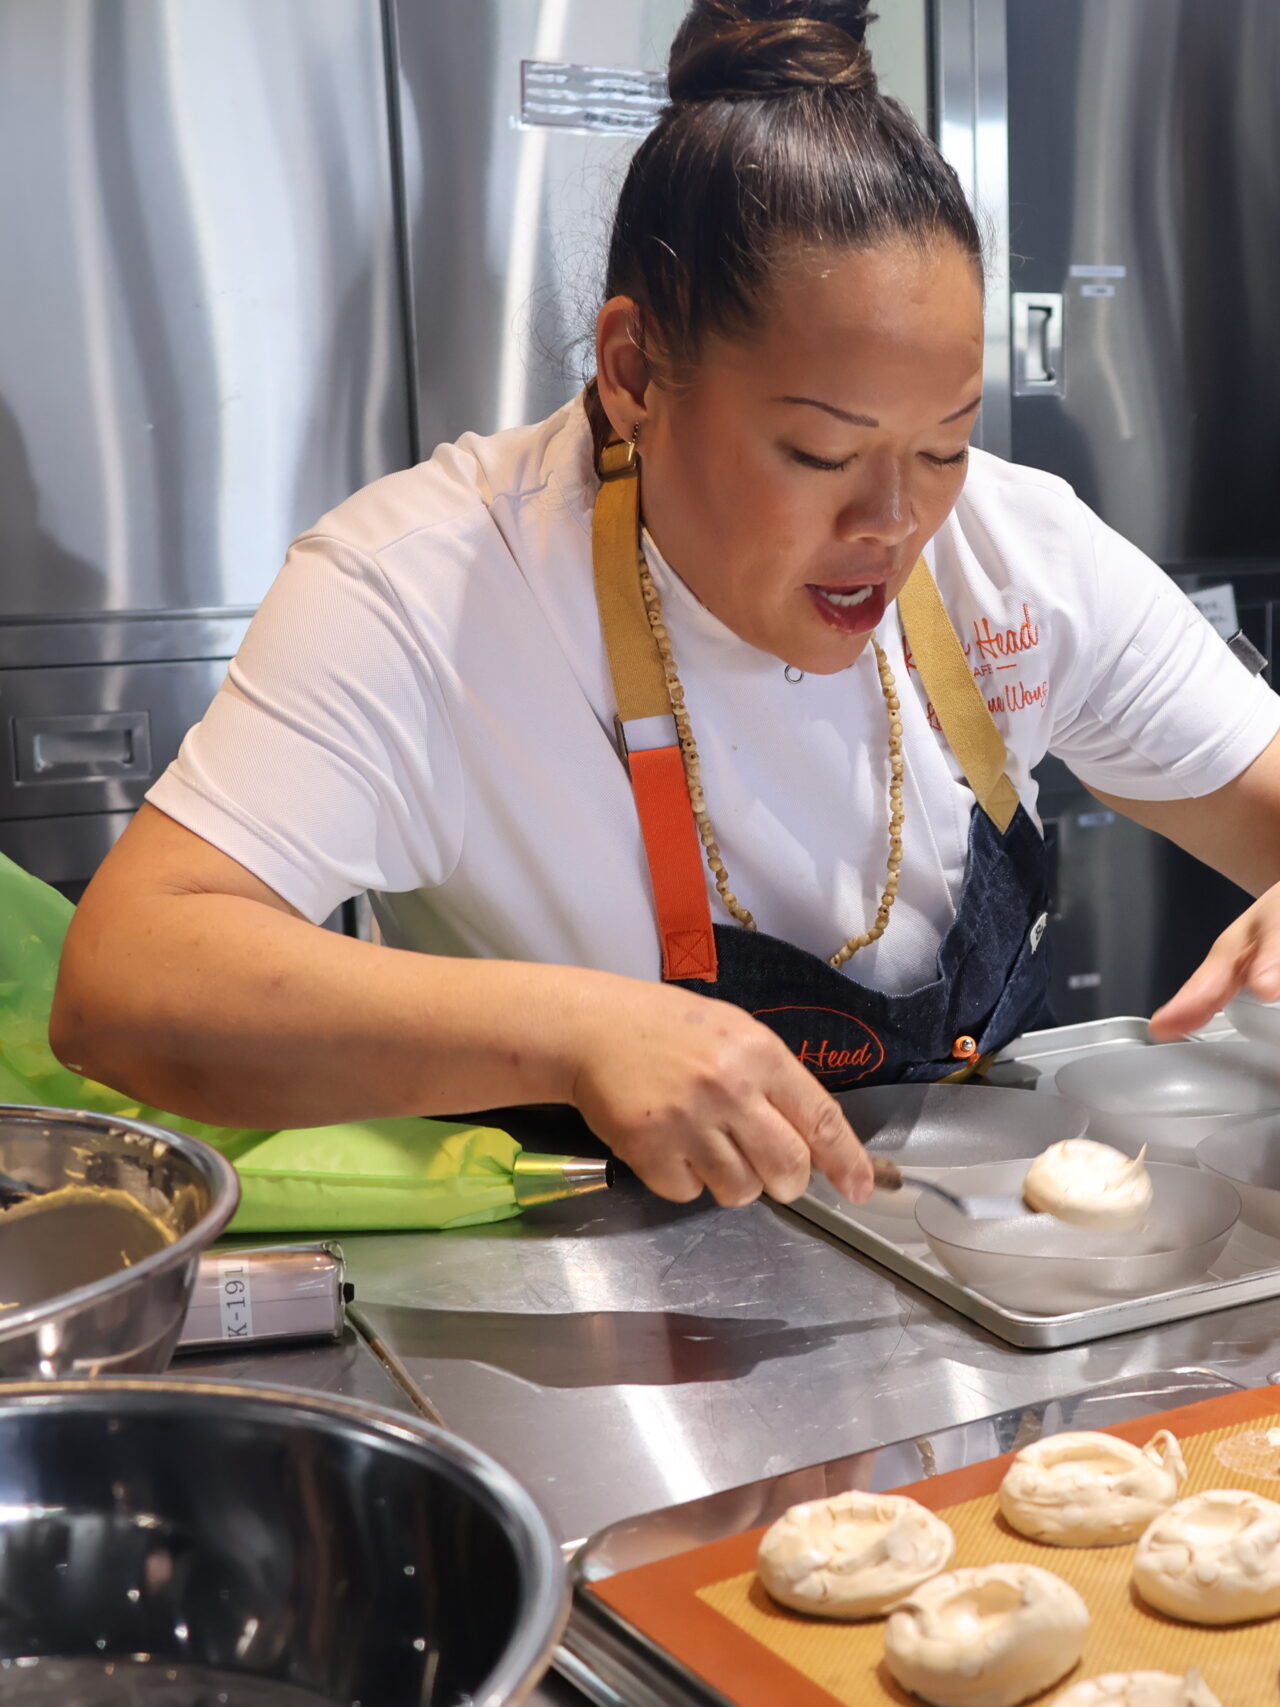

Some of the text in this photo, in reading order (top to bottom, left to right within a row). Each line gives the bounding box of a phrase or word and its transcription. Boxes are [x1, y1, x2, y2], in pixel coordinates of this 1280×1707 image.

[973, 603, 1039, 660] Head
[973, 663, 994, 678] AFE
[1005, 681, 1048, 712] Wong
[796, 1040, 873, 1068] Head
